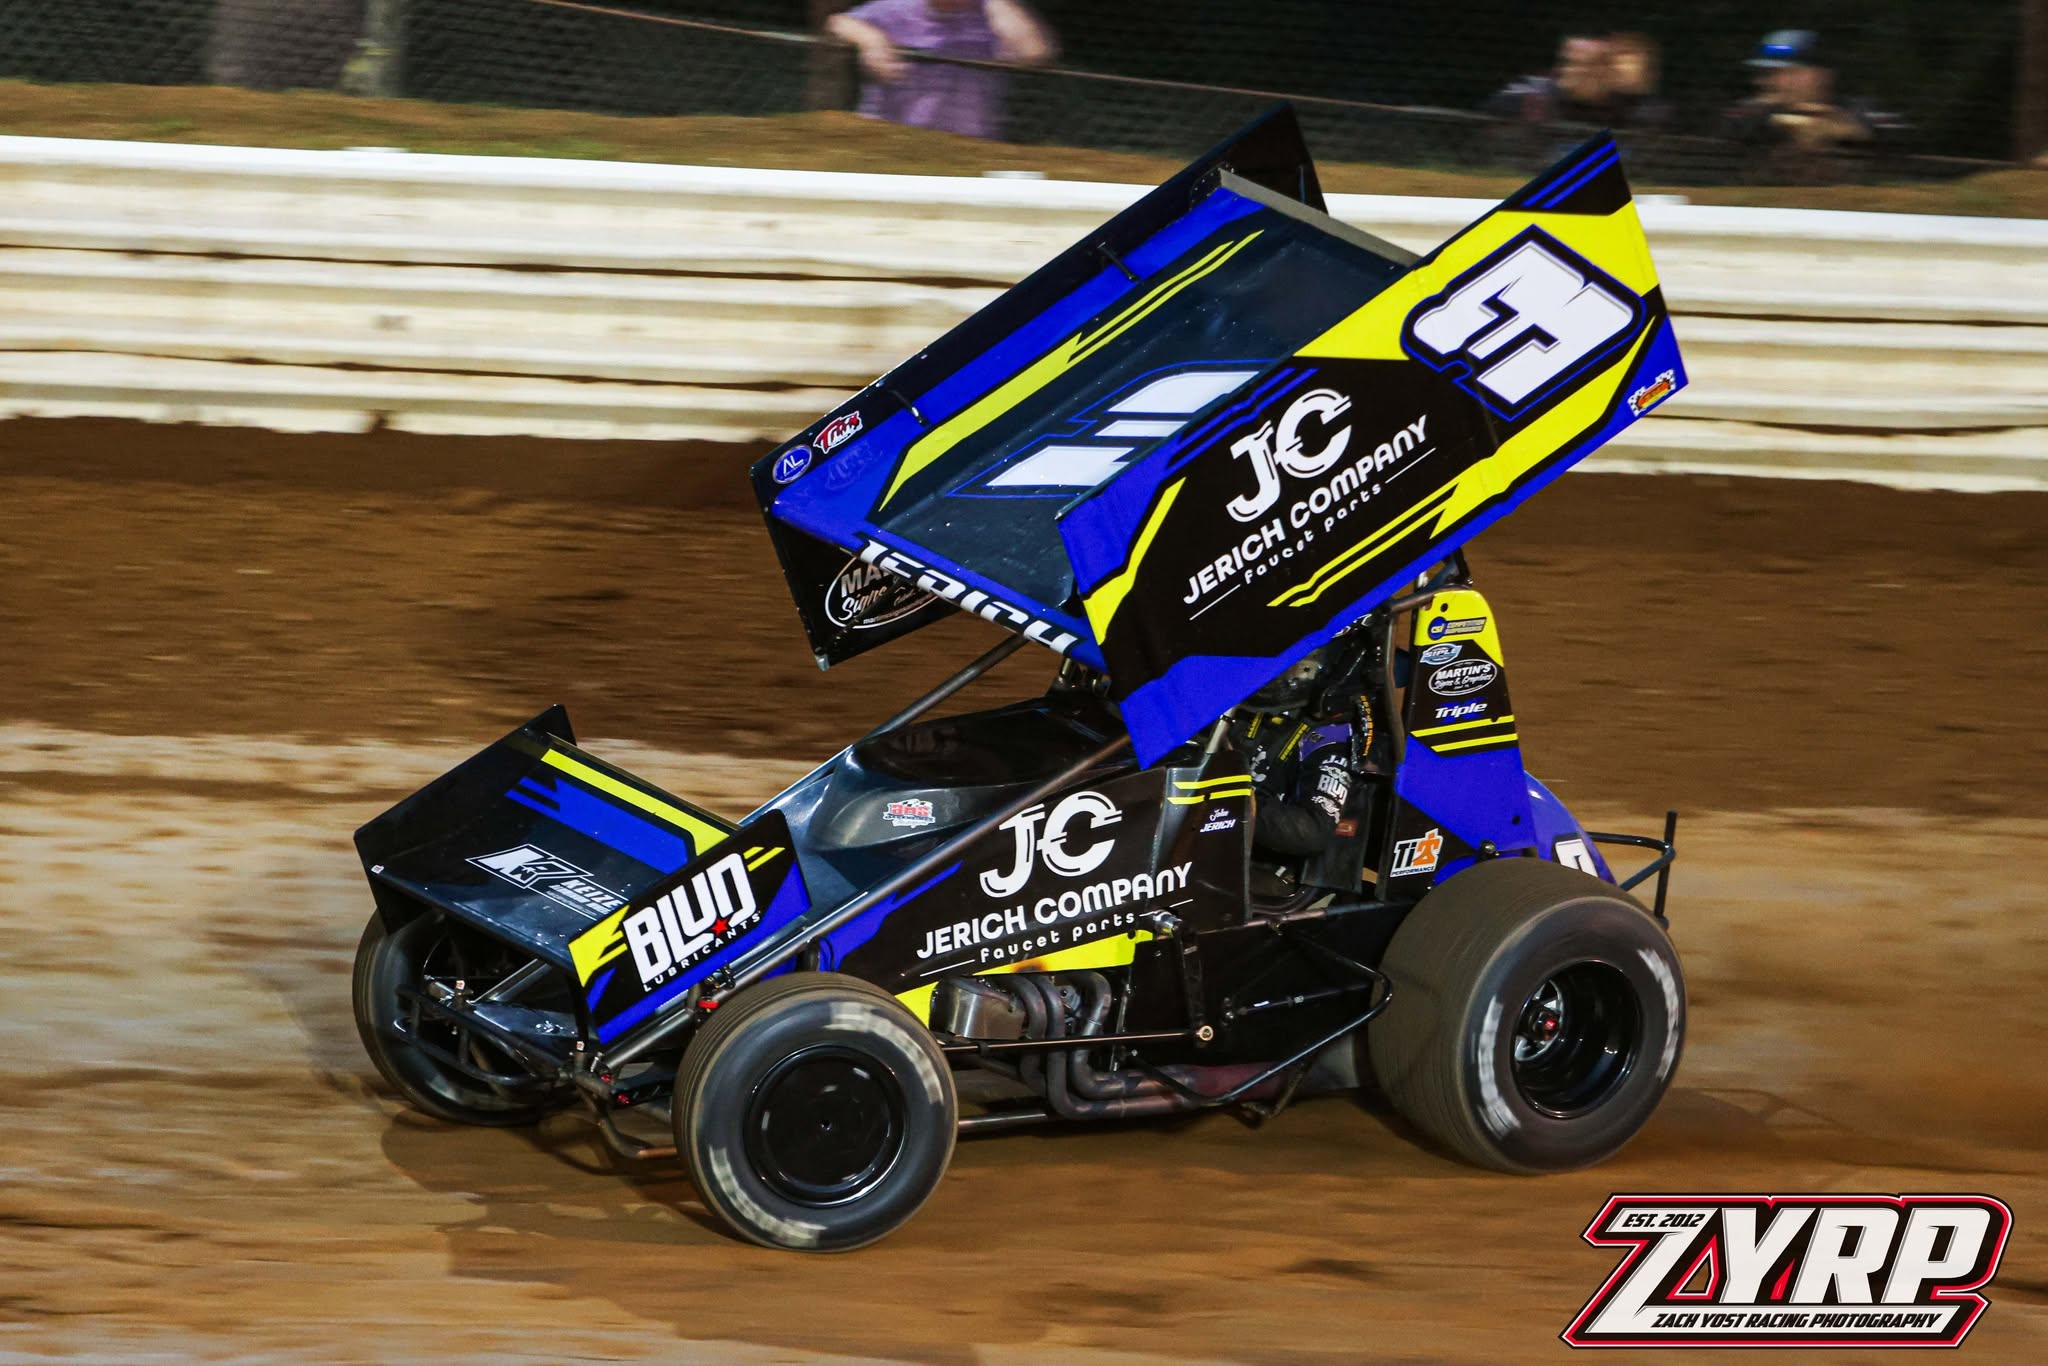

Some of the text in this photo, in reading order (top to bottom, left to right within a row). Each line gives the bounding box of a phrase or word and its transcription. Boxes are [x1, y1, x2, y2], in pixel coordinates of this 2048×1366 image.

[1413, 240, 1634, 405] 3
[1226, 388, 1352, 523] JC
[1183, 518, 1286, 604] JERICH
[1290, 414, 1427, 529] COMPANY
[1244, 483, 1382, 584] faucet parts
[1435, 662, 1491, 681] MARTIN'S
[1435, 702, 1488, 719] Triple
[979, 790, 1123, 898] JC
[1199, 818, 1237, 833] JERICH
[560, 879, 624, 910] KEIZE
[622, 852, 757, 984] BLUD
[917, 861, 1193, 959] JERICH COMPANY
[980, 912, 1136, 963] faucet parts
[643, 913, 761, 992] LUBRICANTS
